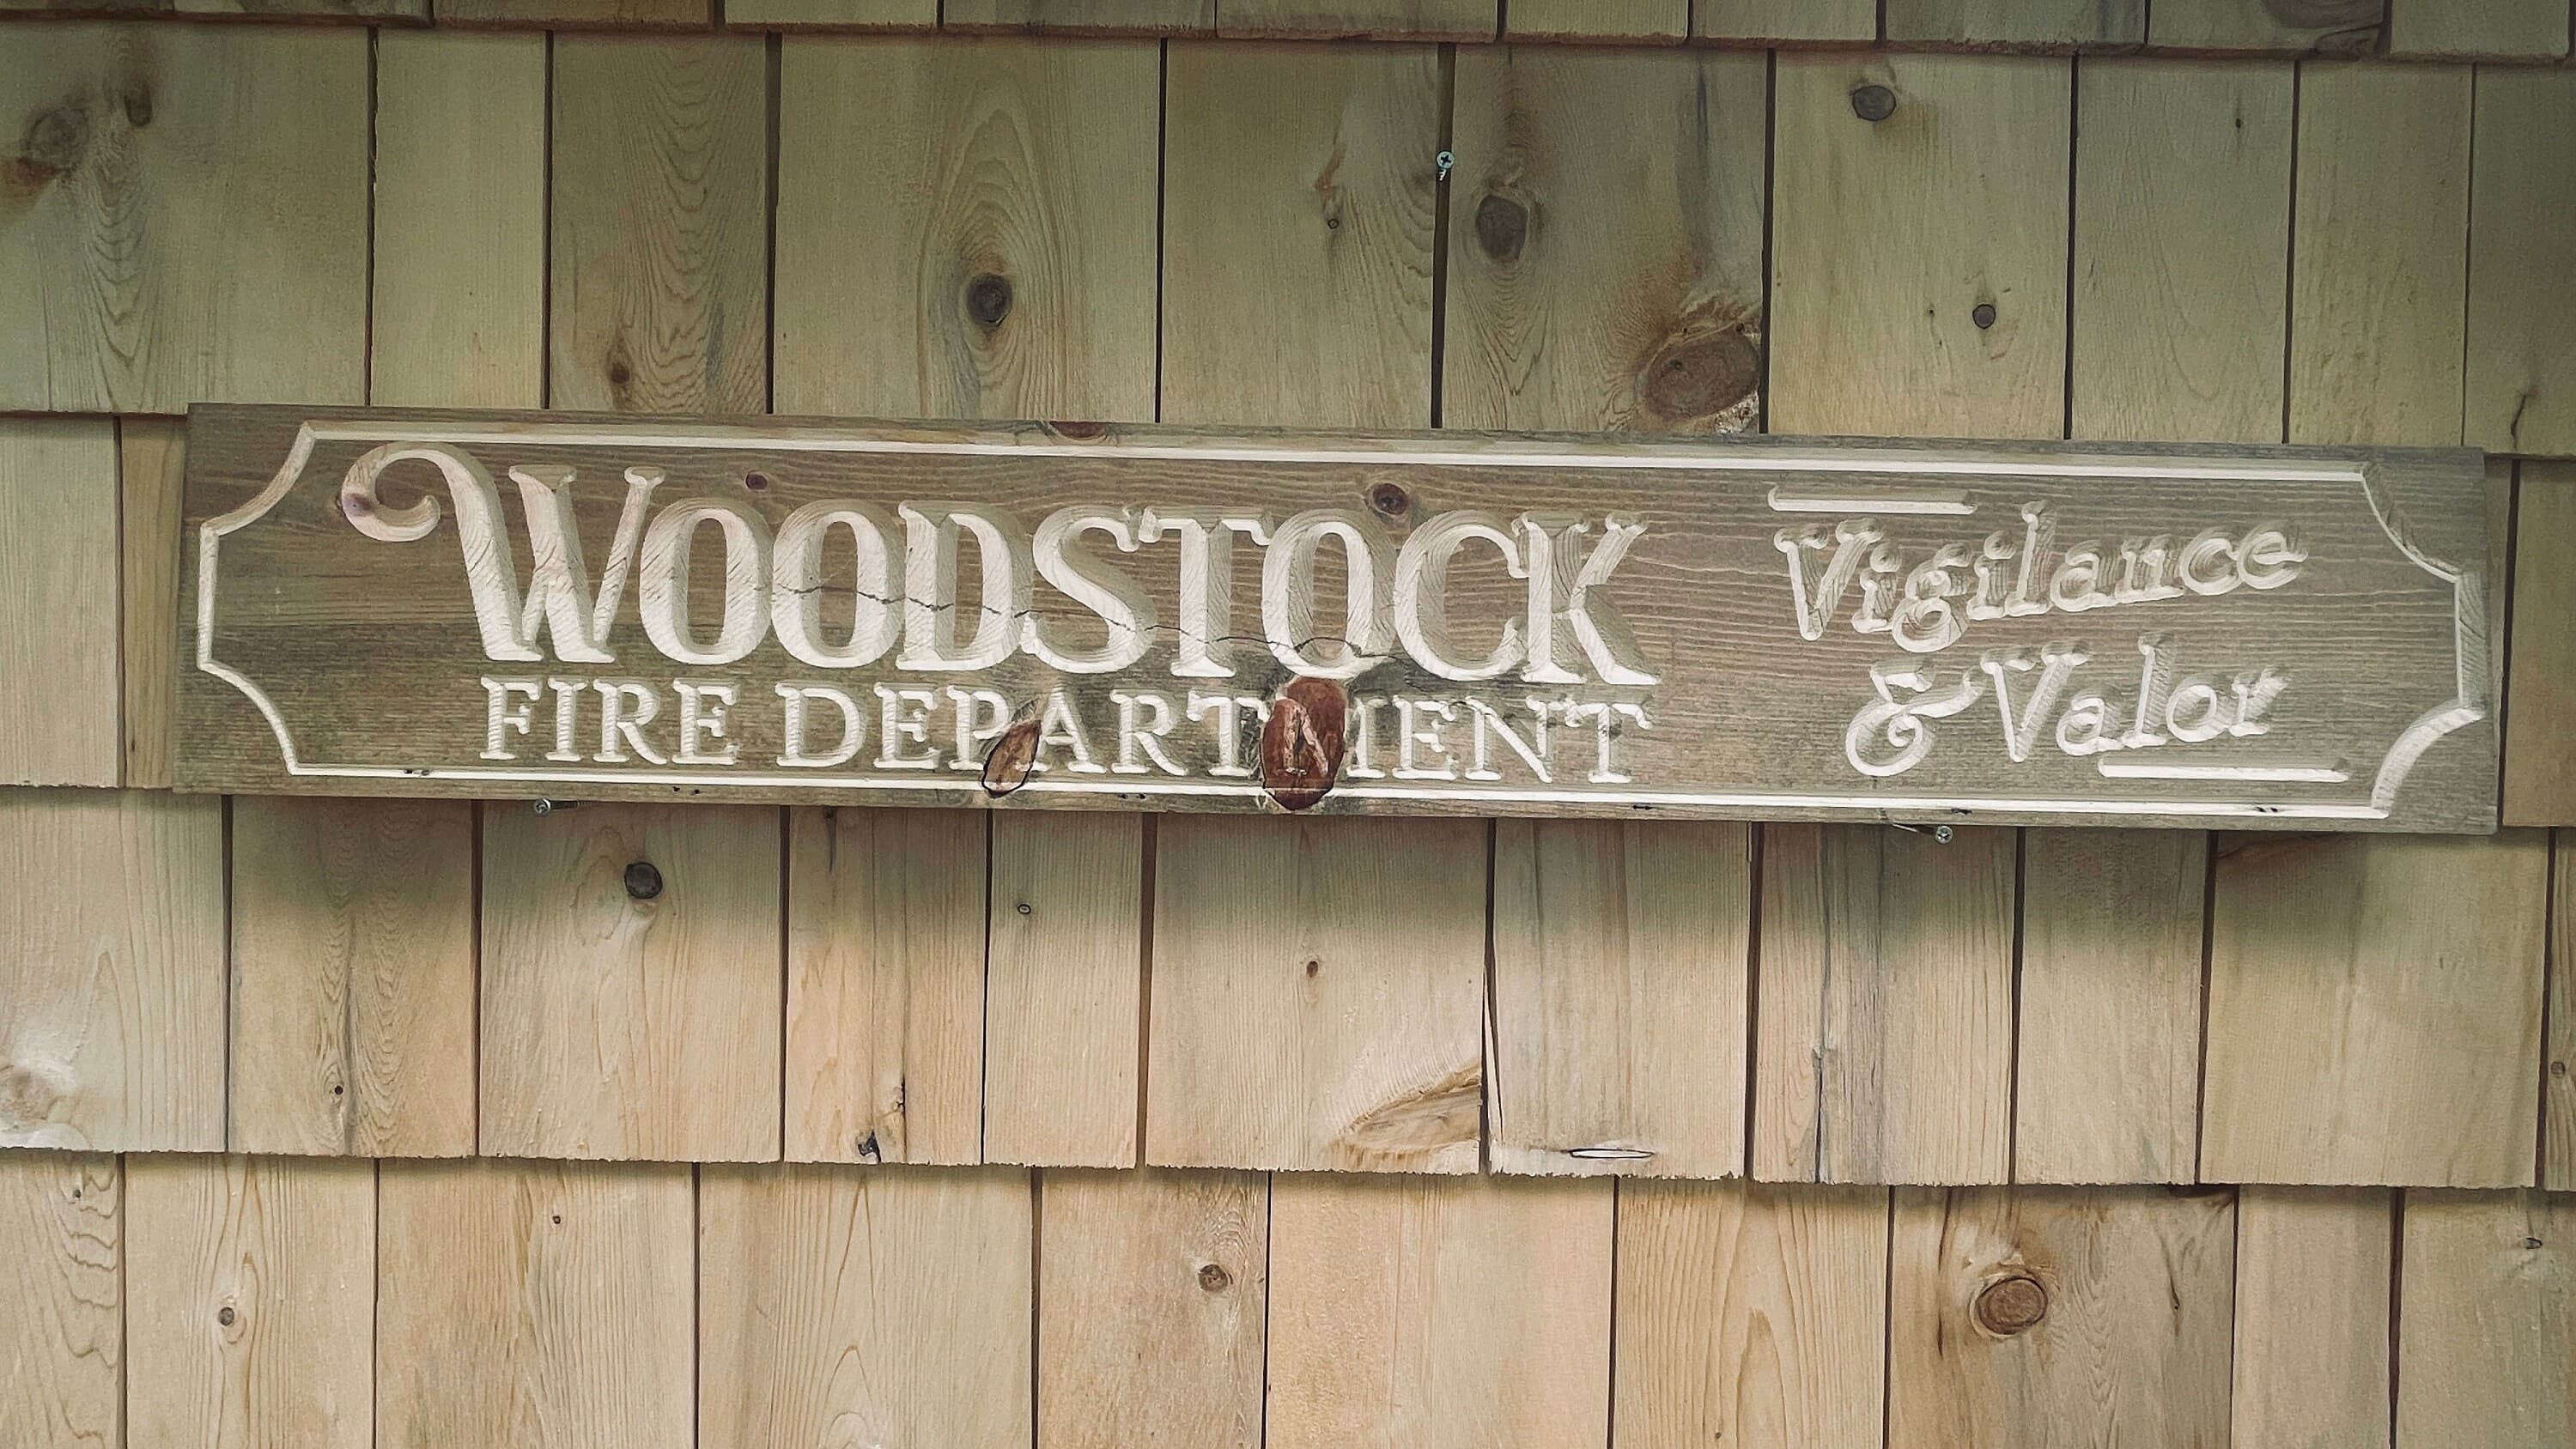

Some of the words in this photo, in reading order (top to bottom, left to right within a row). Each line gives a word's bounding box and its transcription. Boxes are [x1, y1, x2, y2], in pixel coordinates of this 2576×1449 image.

[343, 440, 1661, 685] WOODSTOCK
[1773, 500, 2308, 652] Vigilance
[478, 675, 741, 767] FIRE
[775, 681, 1654, 785] DEPARTMENT
[1845, 657, 1986, 776] &
[1979, 631, 2290, 762] Valor
